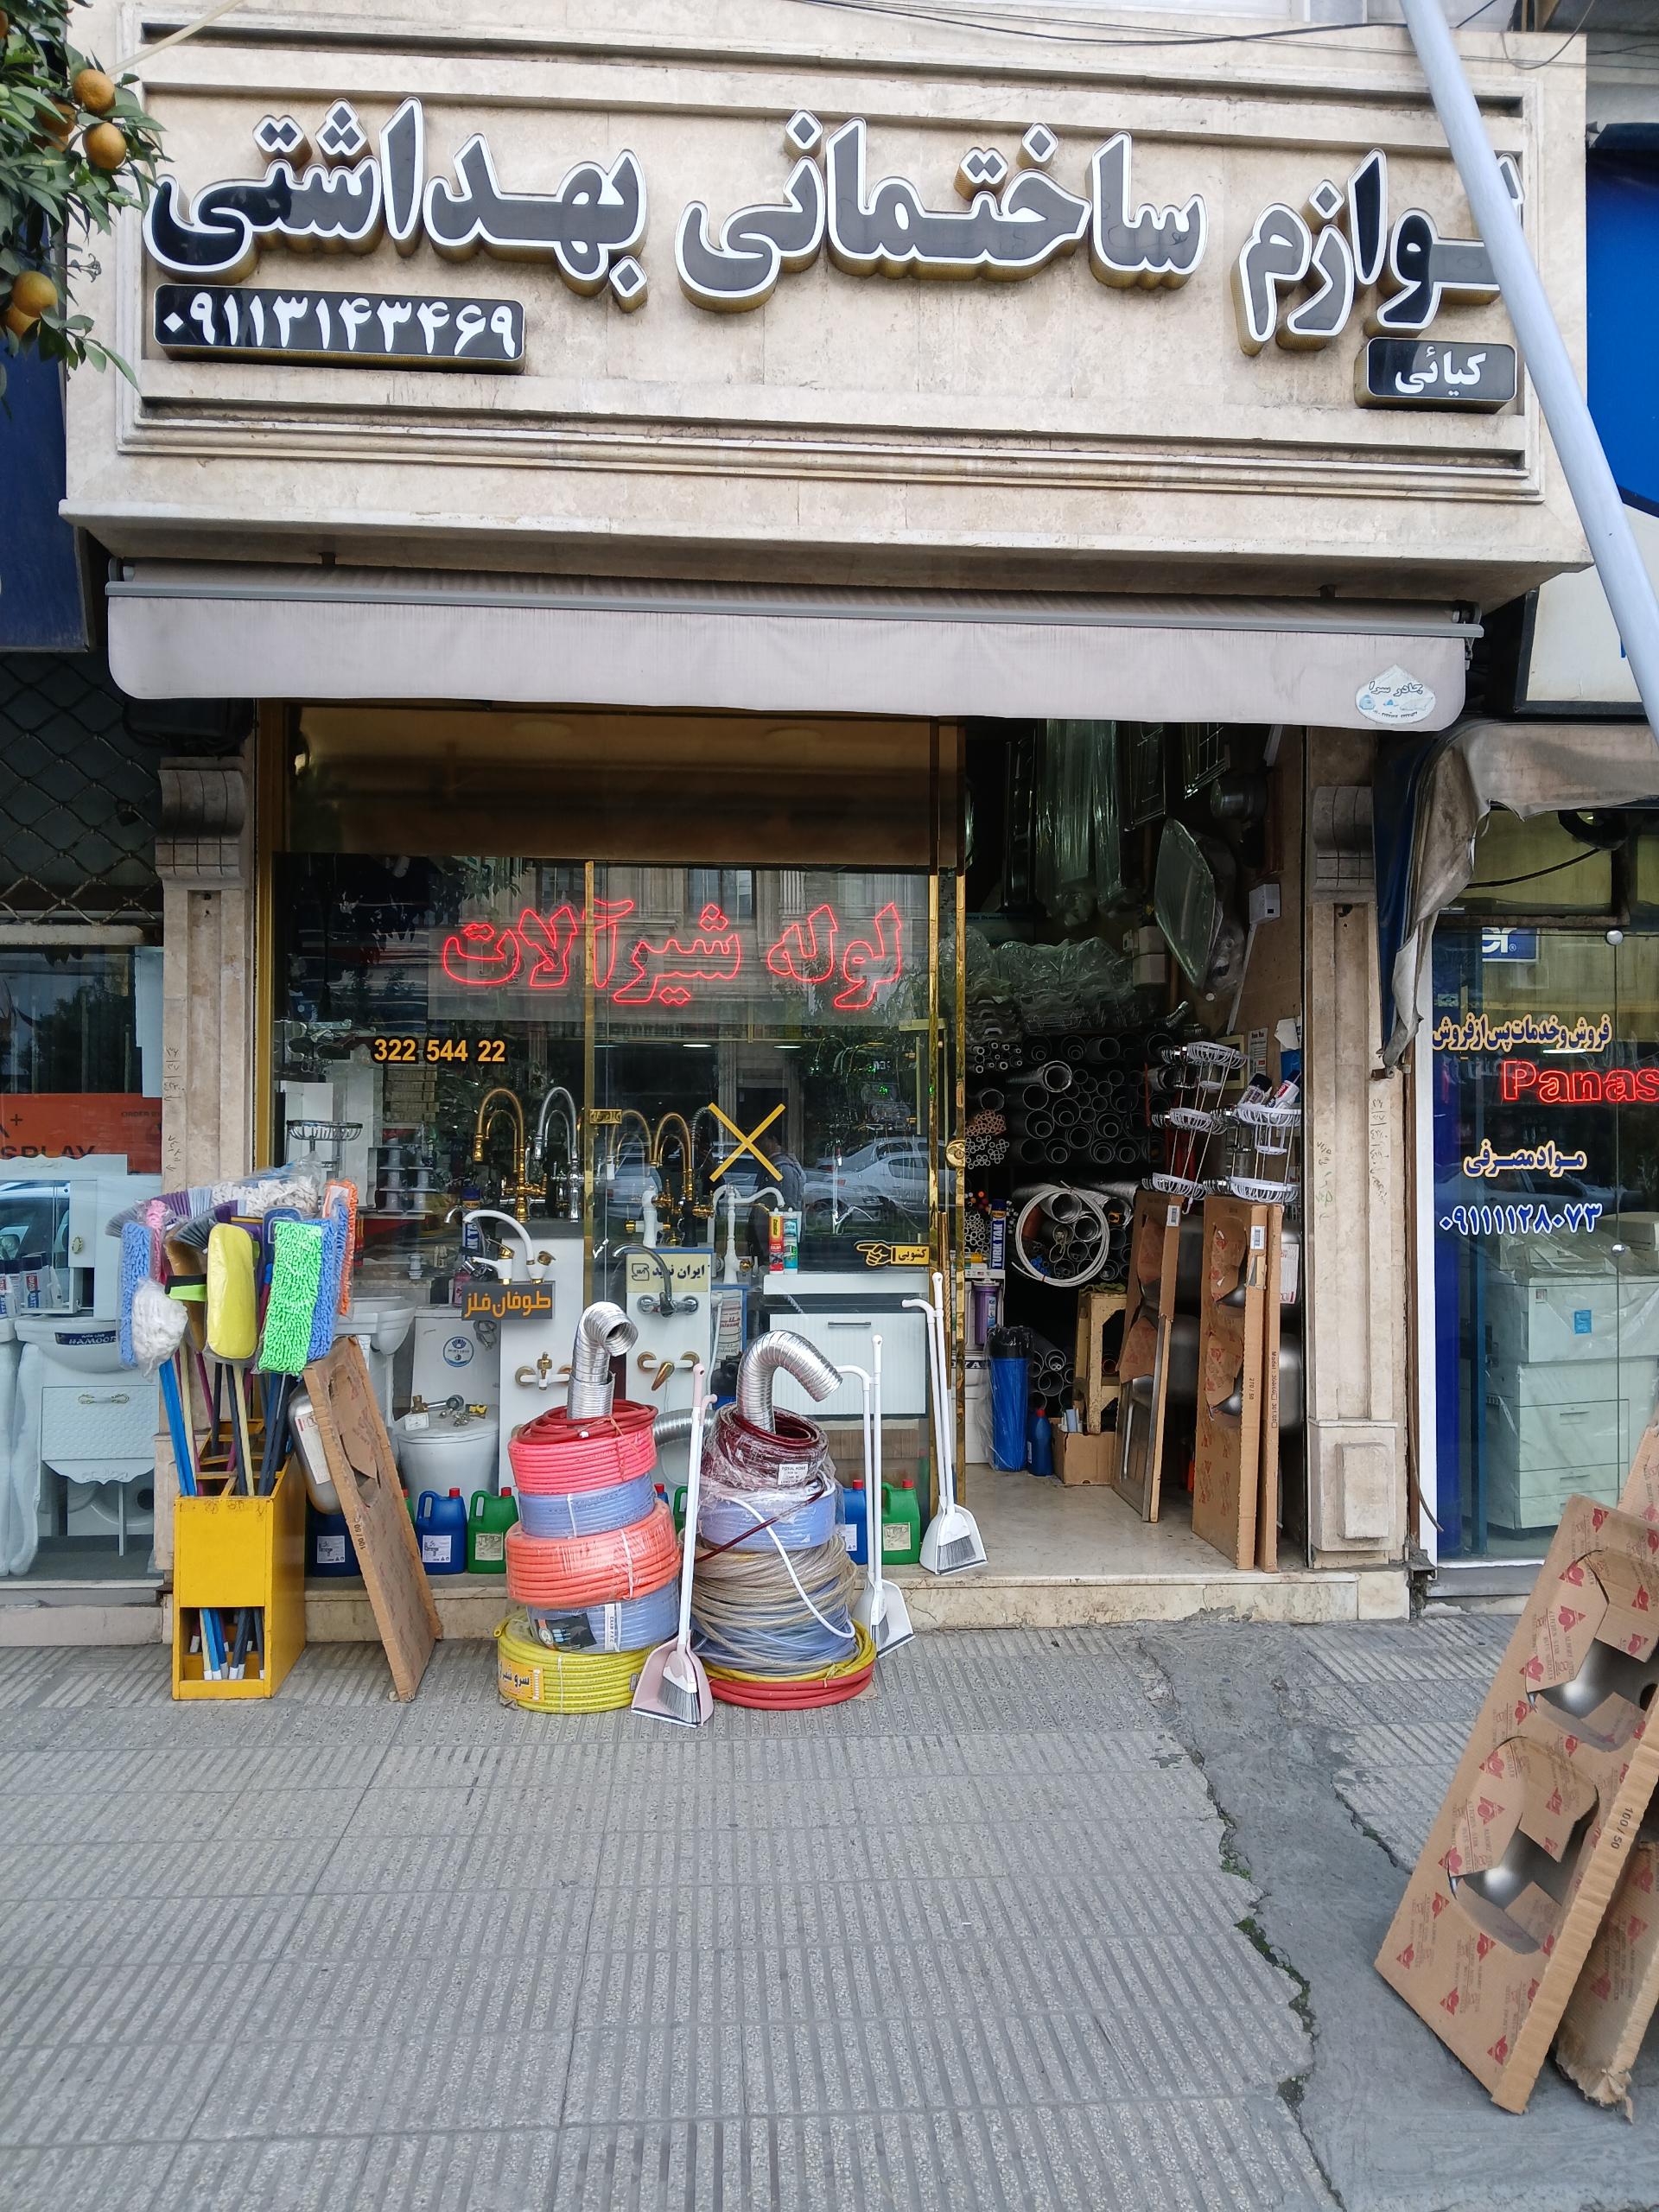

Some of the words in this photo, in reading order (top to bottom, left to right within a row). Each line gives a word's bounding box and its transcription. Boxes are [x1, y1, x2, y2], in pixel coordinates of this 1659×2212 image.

[143, 96, 647, 300] بهداشتی
[675, 110, 1208, 299] ساختمانی
[162, 289, 516, 359] ۰۹۱۱۳۱۴۳۴۶۹
[766, 901, 903, 1010] لوله
[374, 1039, 416, 1062] 322
[426, 1039, 468, 1062] 544
[478, 1039, 505, 1063] 22
[1486, 1021, 1512, 1052] پس
[1501, 1060, 1659, 1103] Panas
[1464, 1138, 1536, 1178] مصرفی
[1535, 1141, 1587, 1178] مواد
[1439, 1203, 1603, 1236] ۰۹۱۱۱۱۲۸۰۷۳
[677, 1264, 705, 1280] ایران
[464, 1292, 491, 1319] فلز
[492, 1290, 551, 1318] طوفان
[1619, 1807, 1634, 1827] 100
[1610, 1834, 1623, 1850] 50
